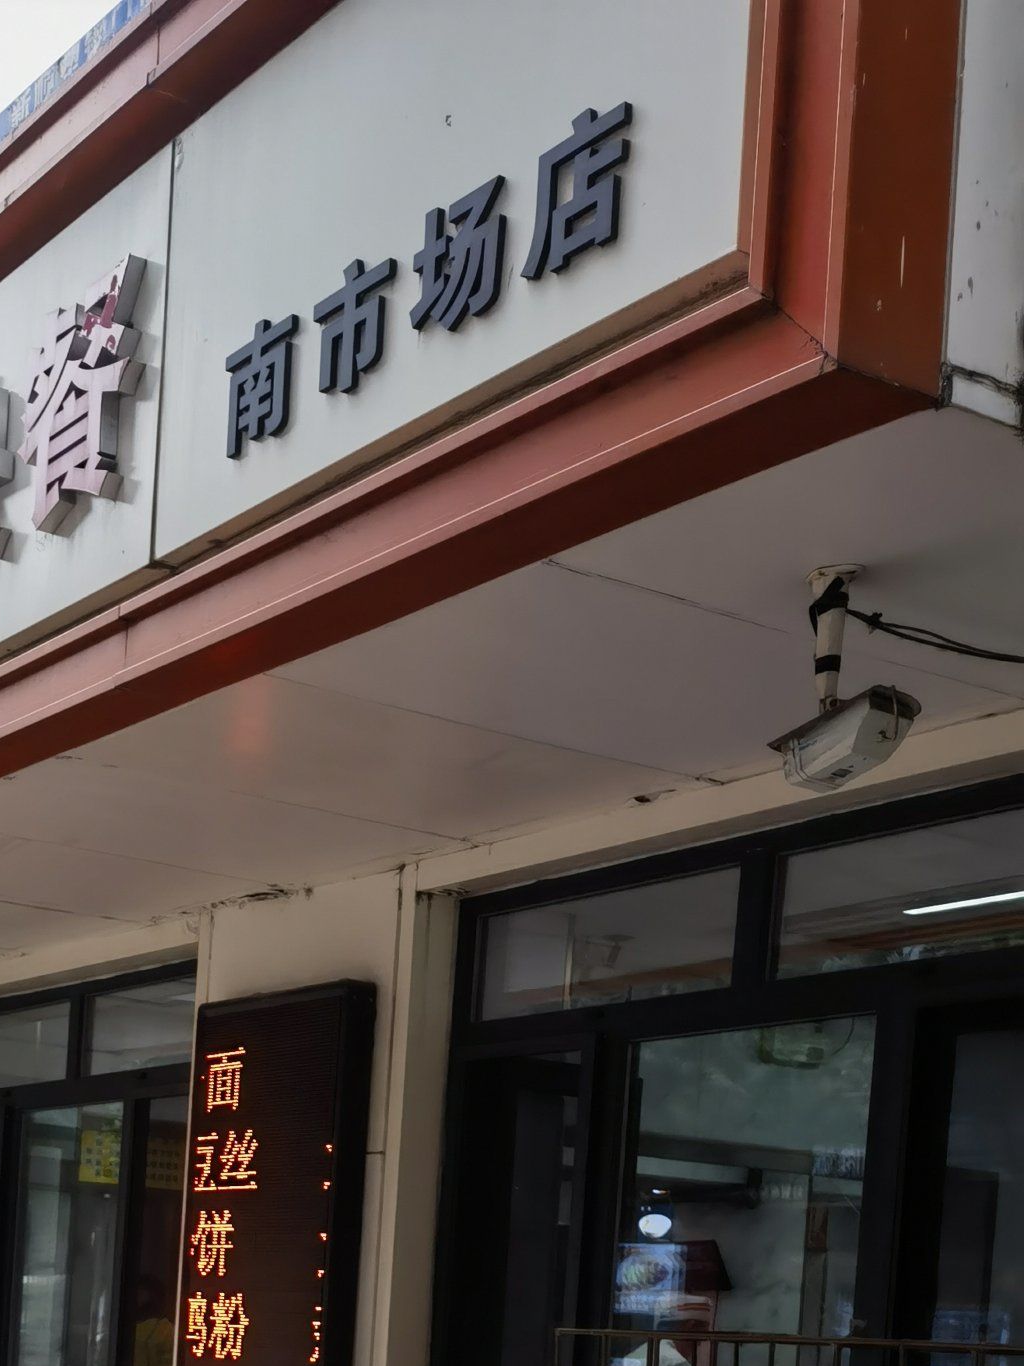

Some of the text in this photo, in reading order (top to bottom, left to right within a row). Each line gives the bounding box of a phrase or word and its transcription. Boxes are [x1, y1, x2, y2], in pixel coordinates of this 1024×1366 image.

[225, 102, 632, 459] 南市场店
[205, 1046, 246, 1113] 面
